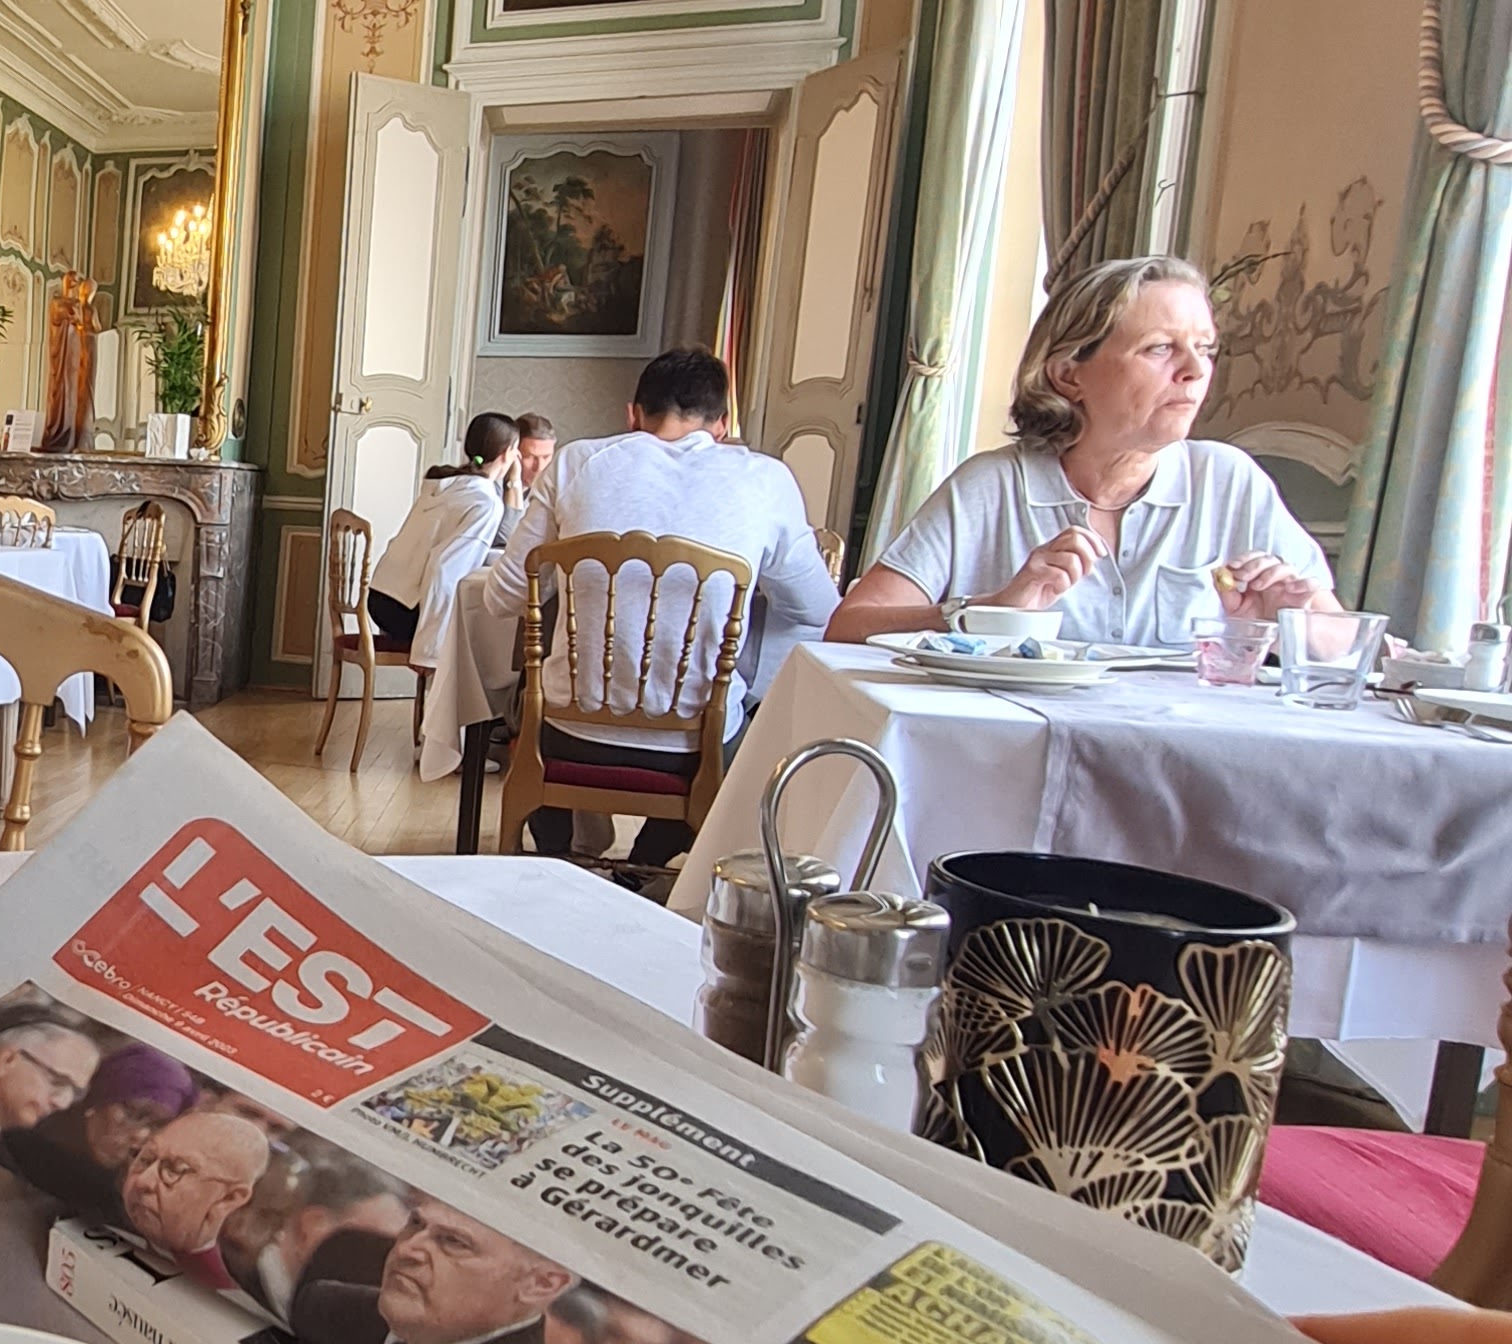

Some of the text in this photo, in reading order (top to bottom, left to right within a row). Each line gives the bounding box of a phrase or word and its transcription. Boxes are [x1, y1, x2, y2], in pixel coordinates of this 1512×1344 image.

[139, 837, 453, 1050] L'EST
[194, 981, 375, 1076] Républicain
[582, 1074, 757, 1168] Supplément
[535, 1157, 719, 1254] se prépare
[561, 1142, 806, 1271] des jonquilles
[584, 1130, 624, 1154] La
[696, 1187, 776, 1229] Fête
[509, 1170, 731, 1289] à Gérardmer
